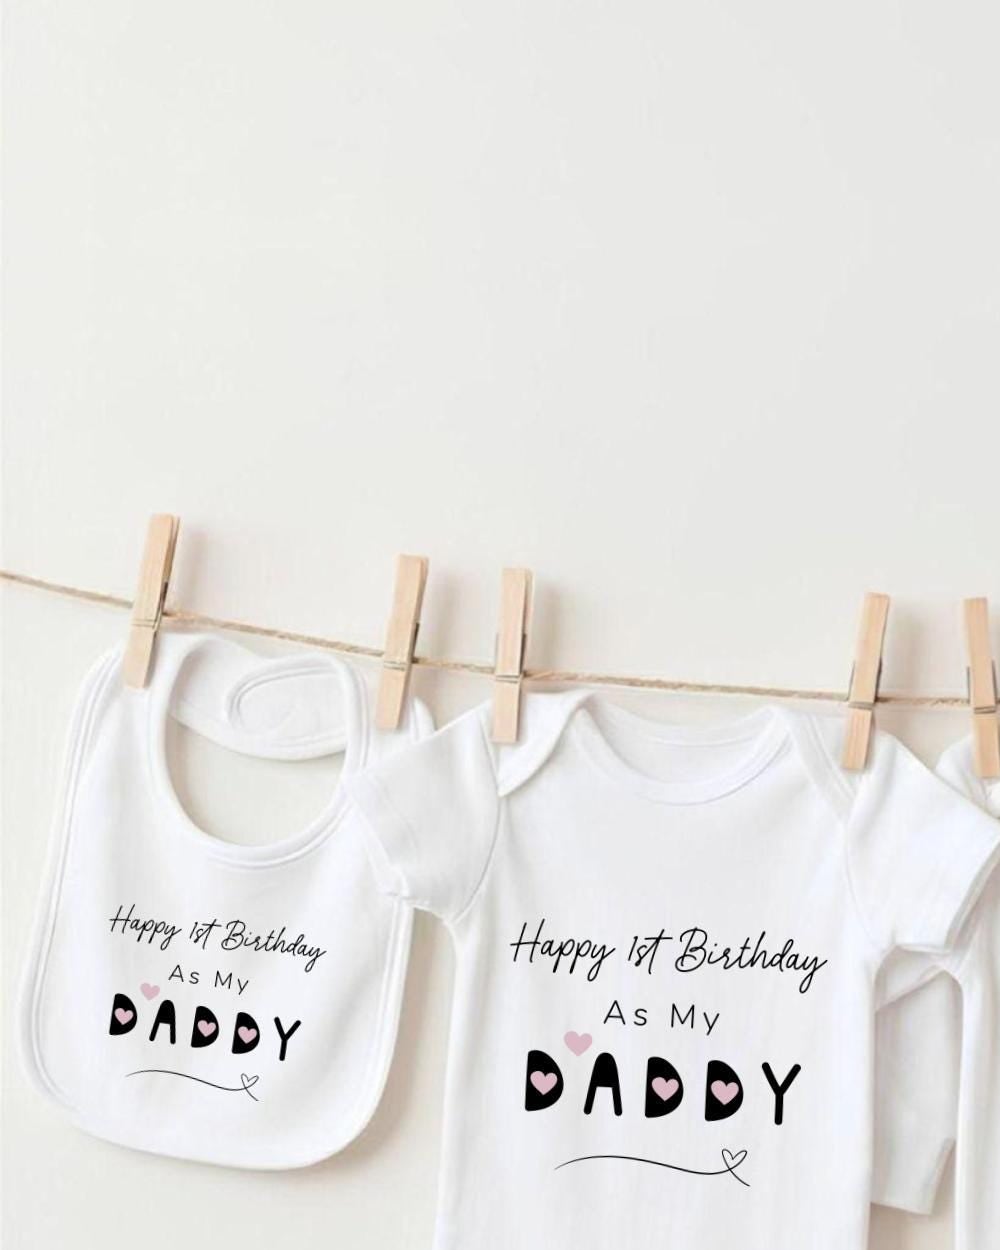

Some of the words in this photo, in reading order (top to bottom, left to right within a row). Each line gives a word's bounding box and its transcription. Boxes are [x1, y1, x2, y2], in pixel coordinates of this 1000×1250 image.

[109, 903, 183, 951] Happy
[189, 918, 222, 950] 1st
[221, 919, 327, 973] Birthday
[510, 918, 616, 982] Happy
[627, 928, 673, 975] 1st
[674, 927, 828, 994] Birthday
[168, 964, 200, 985] As
[214, 970, 249, 995] My
[109, 993, 302, 1062] DADDY
[603, 999, 648, 1027] As
[670, 1003, 720, 1036] My
[524, 1049, 802, 1126] DADDY
